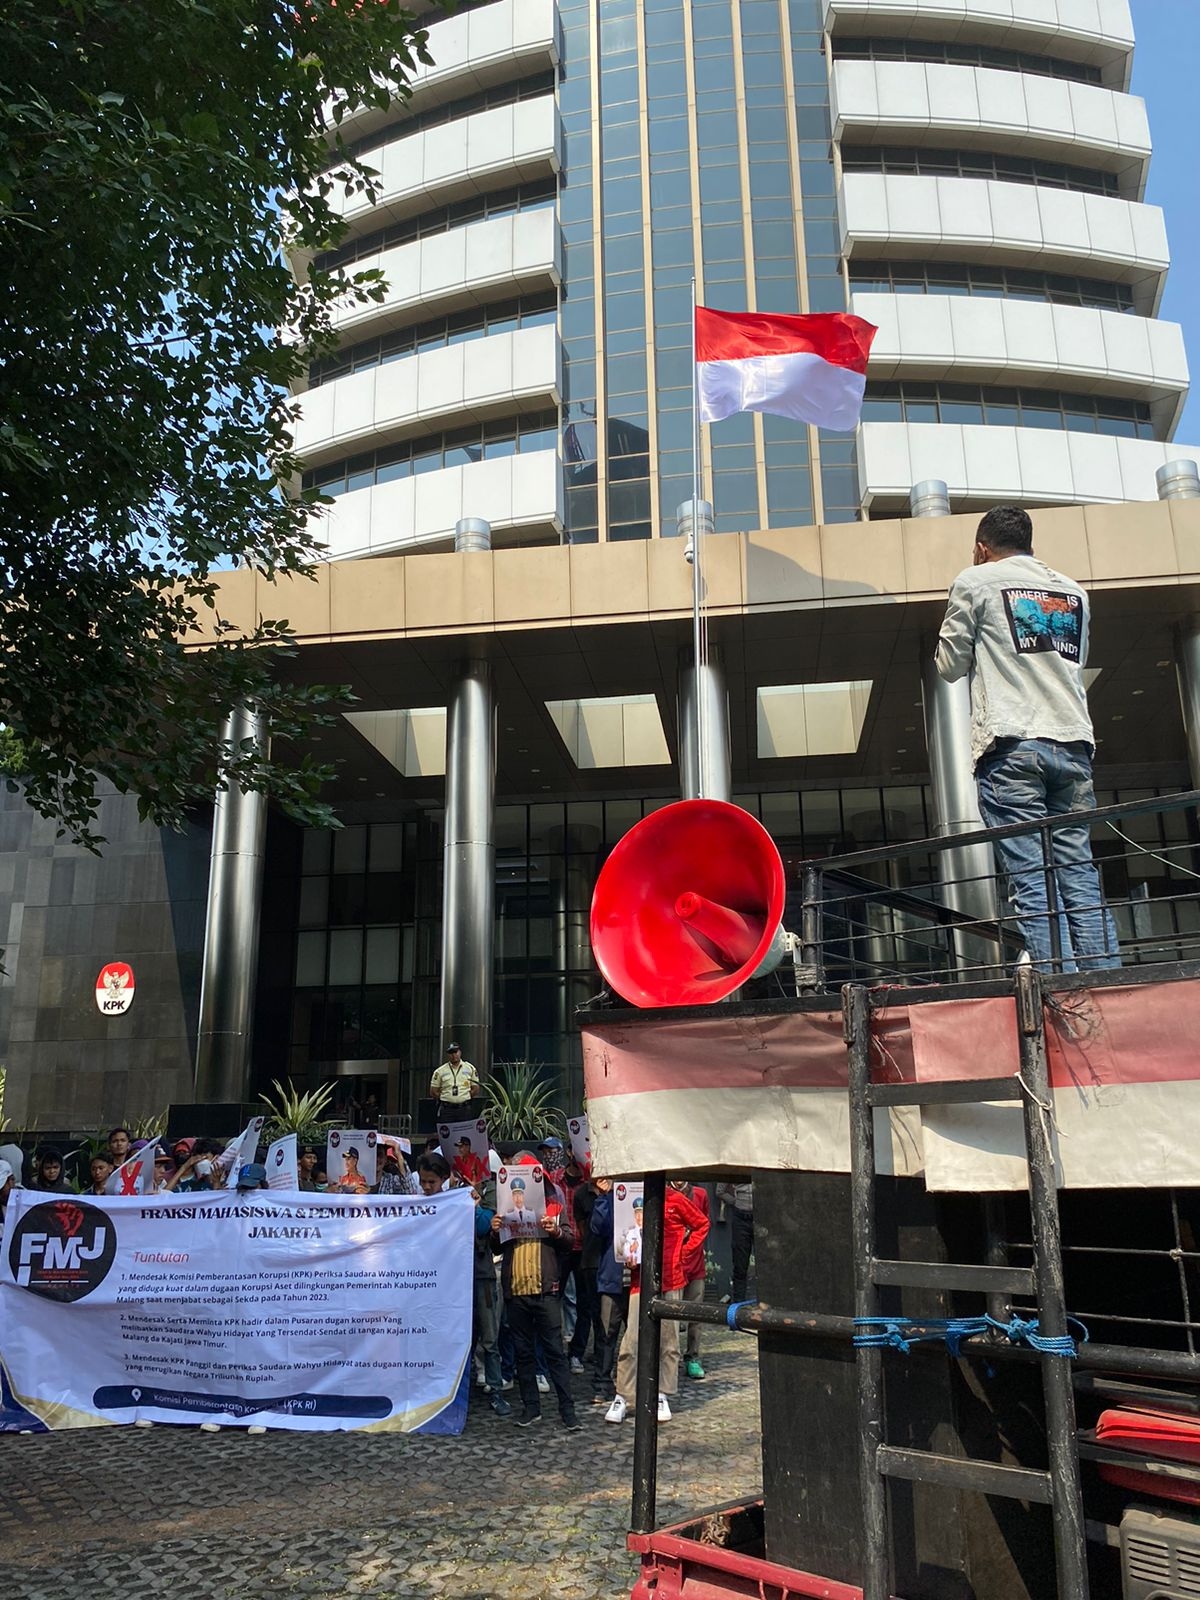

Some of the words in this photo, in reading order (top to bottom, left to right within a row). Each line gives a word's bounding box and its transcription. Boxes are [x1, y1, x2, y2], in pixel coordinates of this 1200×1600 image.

[1006, 590, 1049, 601] WHERE
[1066, 595, 1078, 607] IS
[1019, 636, 1037, 649] MY
[103, 1000, 125, 1010] KPK
[140, 1207, 197, 1219] FRAKSI
[198, 1205, 293, 1219] MAHASISWA
[295, 1207, 306, 1219] &
[308, 1206, 372, 1219] PEMUDA
[374, 1204, 437, 1218] MALANG
[248, 1226, 322, 1239] JAKARTA
[17, 1226, 106, 1286] FMJ
[133, 1251, 190, 1263] Tuntutan
[121, 1273, 127, 1281] 1.
[129, 1273, 168, 1281] Mendesak
[195, 1272, 257, 1281] Pemberantasan
[258, 1271, 290, 1281] Korupsi
[291, 1270, 313, 1280] (KPK)
[314, 1270, 343, 1278] Periksa
[344, 1270, 377, 1278] Saudara
[378, 1270, 405, 1280] Wahyu
[406, 1269, 438, 1279] Hidayat
[118, 1286, 138, 1295] yang
[138, 1285, 164, 1294] diduga
[185, 1284, 209, 1292] dalam
[210, 1284, 240, 1294] dugaan
[241, 1283, 273, 1293] Korupsi
[274, 1282, 292, 1290] Aset
[293, 1281, 345, 1291] dilingkungan
[346, 1281, 392, 1290] Pemerintah
[393, 1281, 437, 1290] Kabupaten
[116, 1296, 145, 1305] Malang
[164, 1296, 202, 1305] menjabat
[203, 1295, 233, 1305] sebagai
[235, 1295, 259, 1303] Sekda
[261, 1294, 281, 1304] pada
[283, 1293, 308, 1301] Tahun
[309, 1293, 329, 1301] 2023.
[128, 1315, 165, 1323] Mendesak
[166, 1317, 187, 1325] Serta
[188, 1318, 222, 1326] Meminta
[224, 1318, 240, 1326] KPK
[241, 1318, 262, 1326] hadir
[264, 1317, 290, 1325] dalam
[291, 1317, 324, 1325] Pusaran
[325, 1316, 349, 1326] dugan
[383, 1316, 402, 1325] Yang
[164, 1326, 195, 1335] Saudara
[195, 1328, 222, 1339] Wahyu
[223, 1330, 254, 1339] Hidayat
[255, 1330, 276, 1338] Yang
[277, 1328, 346, 1336] Tersendat-Sendat
[348, 1327, 356, 1335] di
[357, 1328, 385, 1336] tangan
[386, 1327, 410, 1336] Kajari
[122, 1333, 150, 1343] Malang
[161, 1336, 183, 1346] Kajati
[184, 1338, 202, 1346] Jawa
[203, 1340, 228, 1349] Timur.
[132, 1354, 169, 1363] Mendesak
[170, 1356, 185, 1364] KPK
[186, 1358, 211, 1370] Panggil
[212, 1362, 227, 1370] dan
[228, 1363, 257, 1372] Periksa
[258, 1363, 292, 1371] Saudara
[293, 1361, 322, 1370] Wahyu
[354, 1360, 371, 1368] atas
[372, 1360, 402, 1369] dugaan
[404, 1360, 435, 1369] Korupsi
[125, 1363, 143, 1372] yang
[143, 1365, 182, 1375] merugikan
[183, 1369, 209, 1380] Negara
[245, 1374, 276, 1384] Rupiah.
[153, 1394, 181, 1404] Komisi
